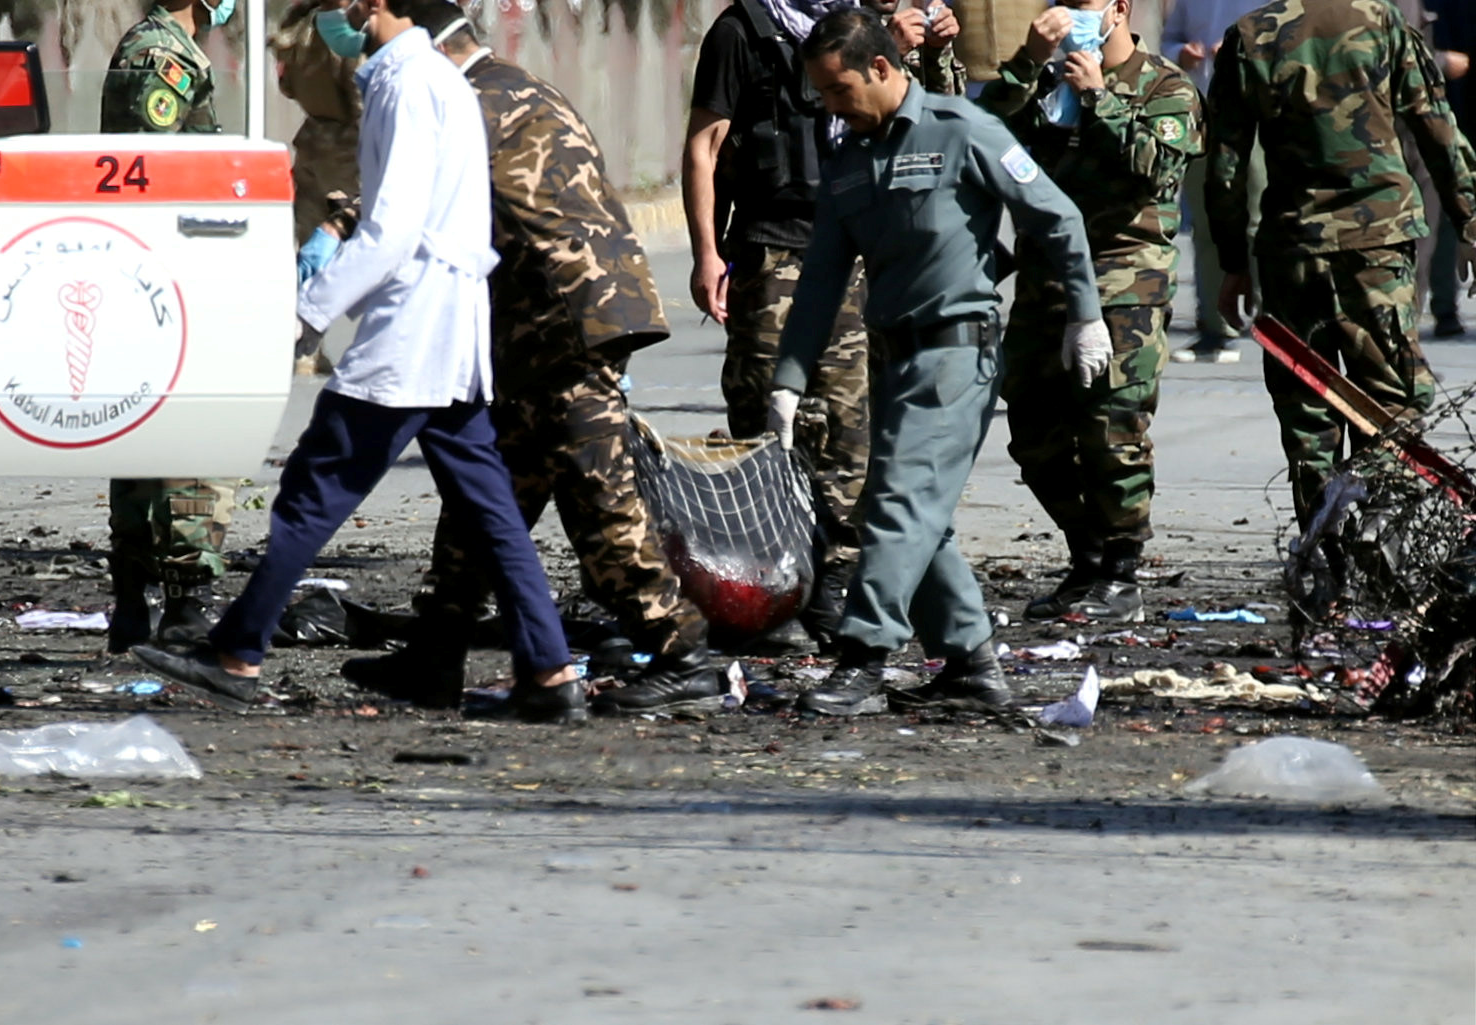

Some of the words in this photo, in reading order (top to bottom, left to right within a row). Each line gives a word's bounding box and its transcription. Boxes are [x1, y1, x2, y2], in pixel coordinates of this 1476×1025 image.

[95, 155, 150, 194] 24
[2, 375, 52, 425] Kabul
[49, 380, 153, 430] Ambulance
